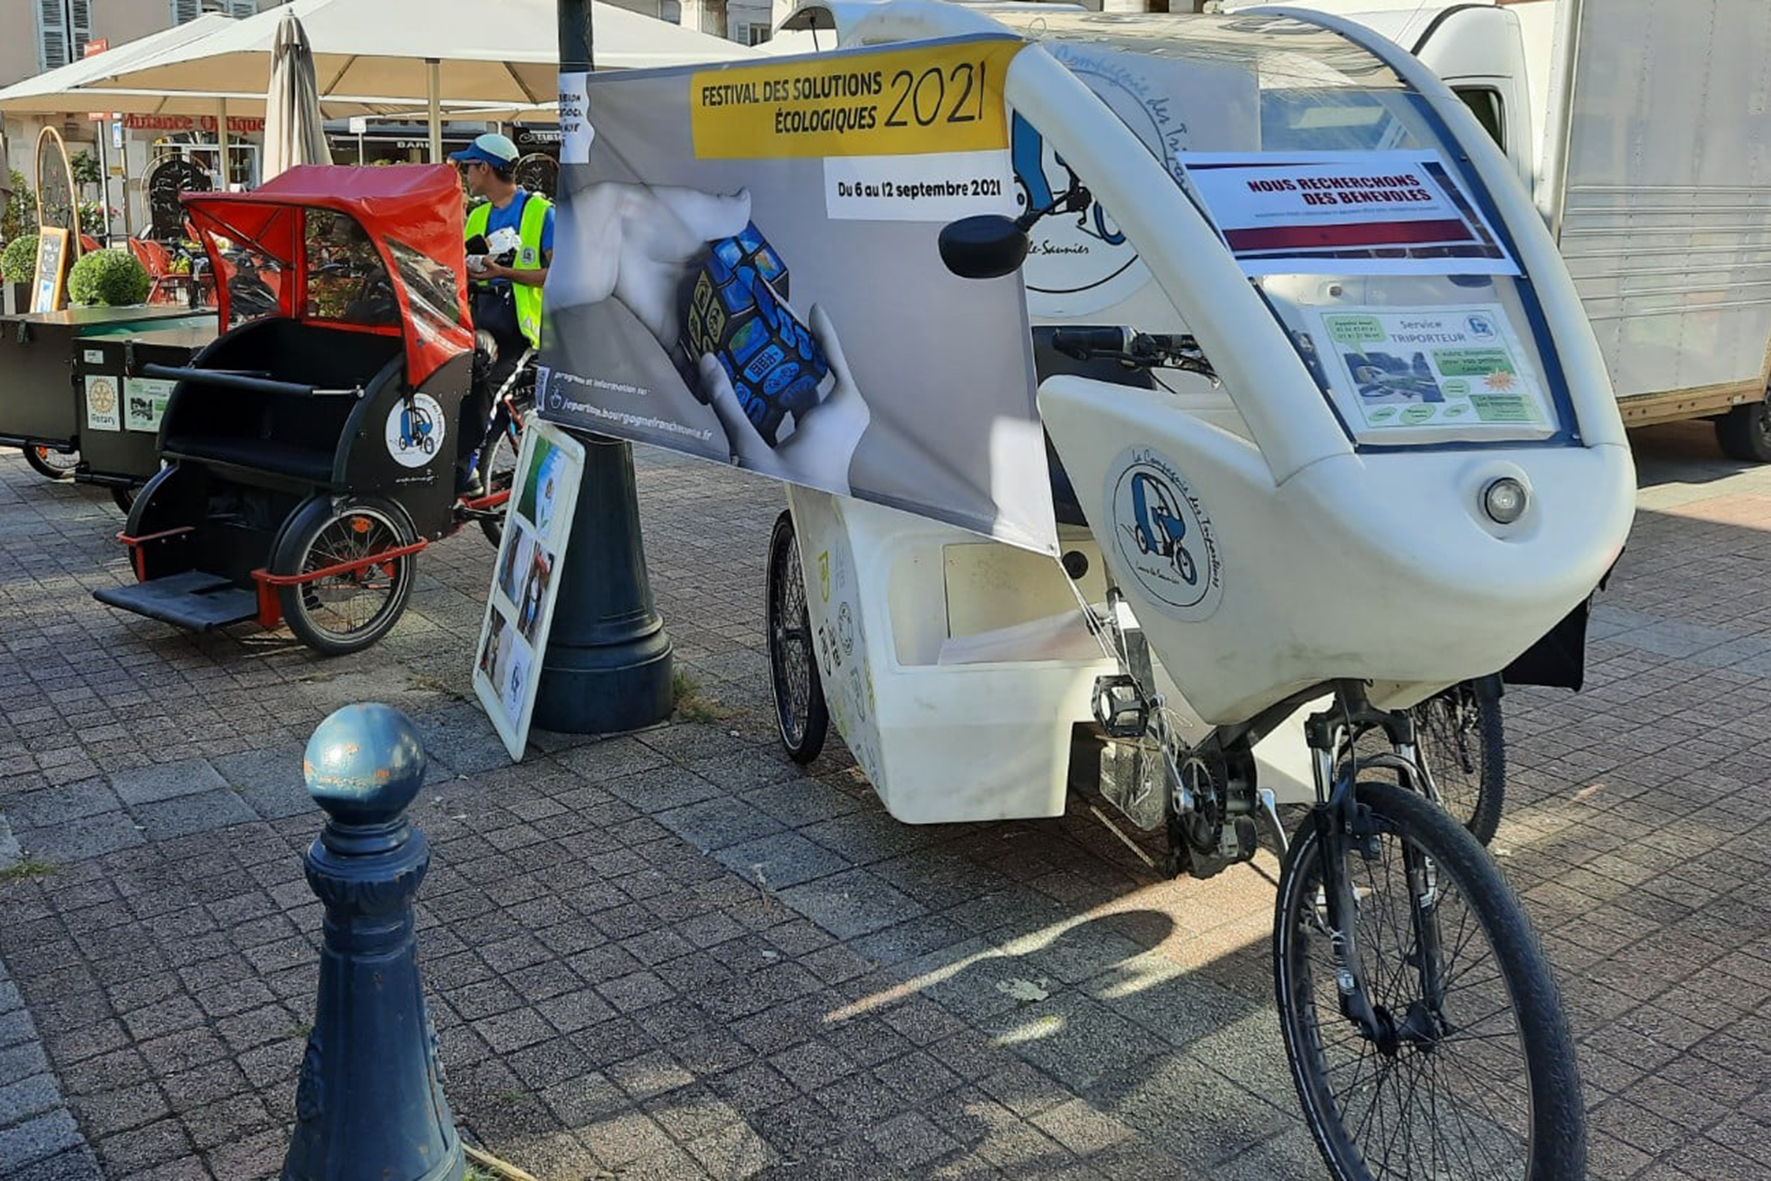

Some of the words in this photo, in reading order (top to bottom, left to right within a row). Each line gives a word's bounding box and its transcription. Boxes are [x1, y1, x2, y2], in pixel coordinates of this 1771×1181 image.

[702, 83, 759, 106] FESTIVAL
[763, 79, 789, 102] DES
[793, 71, 882, 100] SOLUTIONS
[885, 61, 986, 127] 2021
[775, 106, 877, 134] ÉCOLOGIQUES
[1146, 98, 1170, 126] des
[838, 182, 853, 198] Du
[855, 182, 863, 198] 6
[865, 184, 879, 198] au
[882, 182, 893, 198] 12
[896, 180, 968, 200] septembre
[971, 179, 1001, 196] 2021
[1246, 178, 1296, 193] NOUS
[1296, 174, 1421, 191] RECHERCHONS
[1301, 191, 1338, 206] DES
[1337, 188, 1433, 206] BENEVOLES
[1400, 319, 1442, 330] Service
[1390, 332, 1467, 344] TRIPORTEUR
